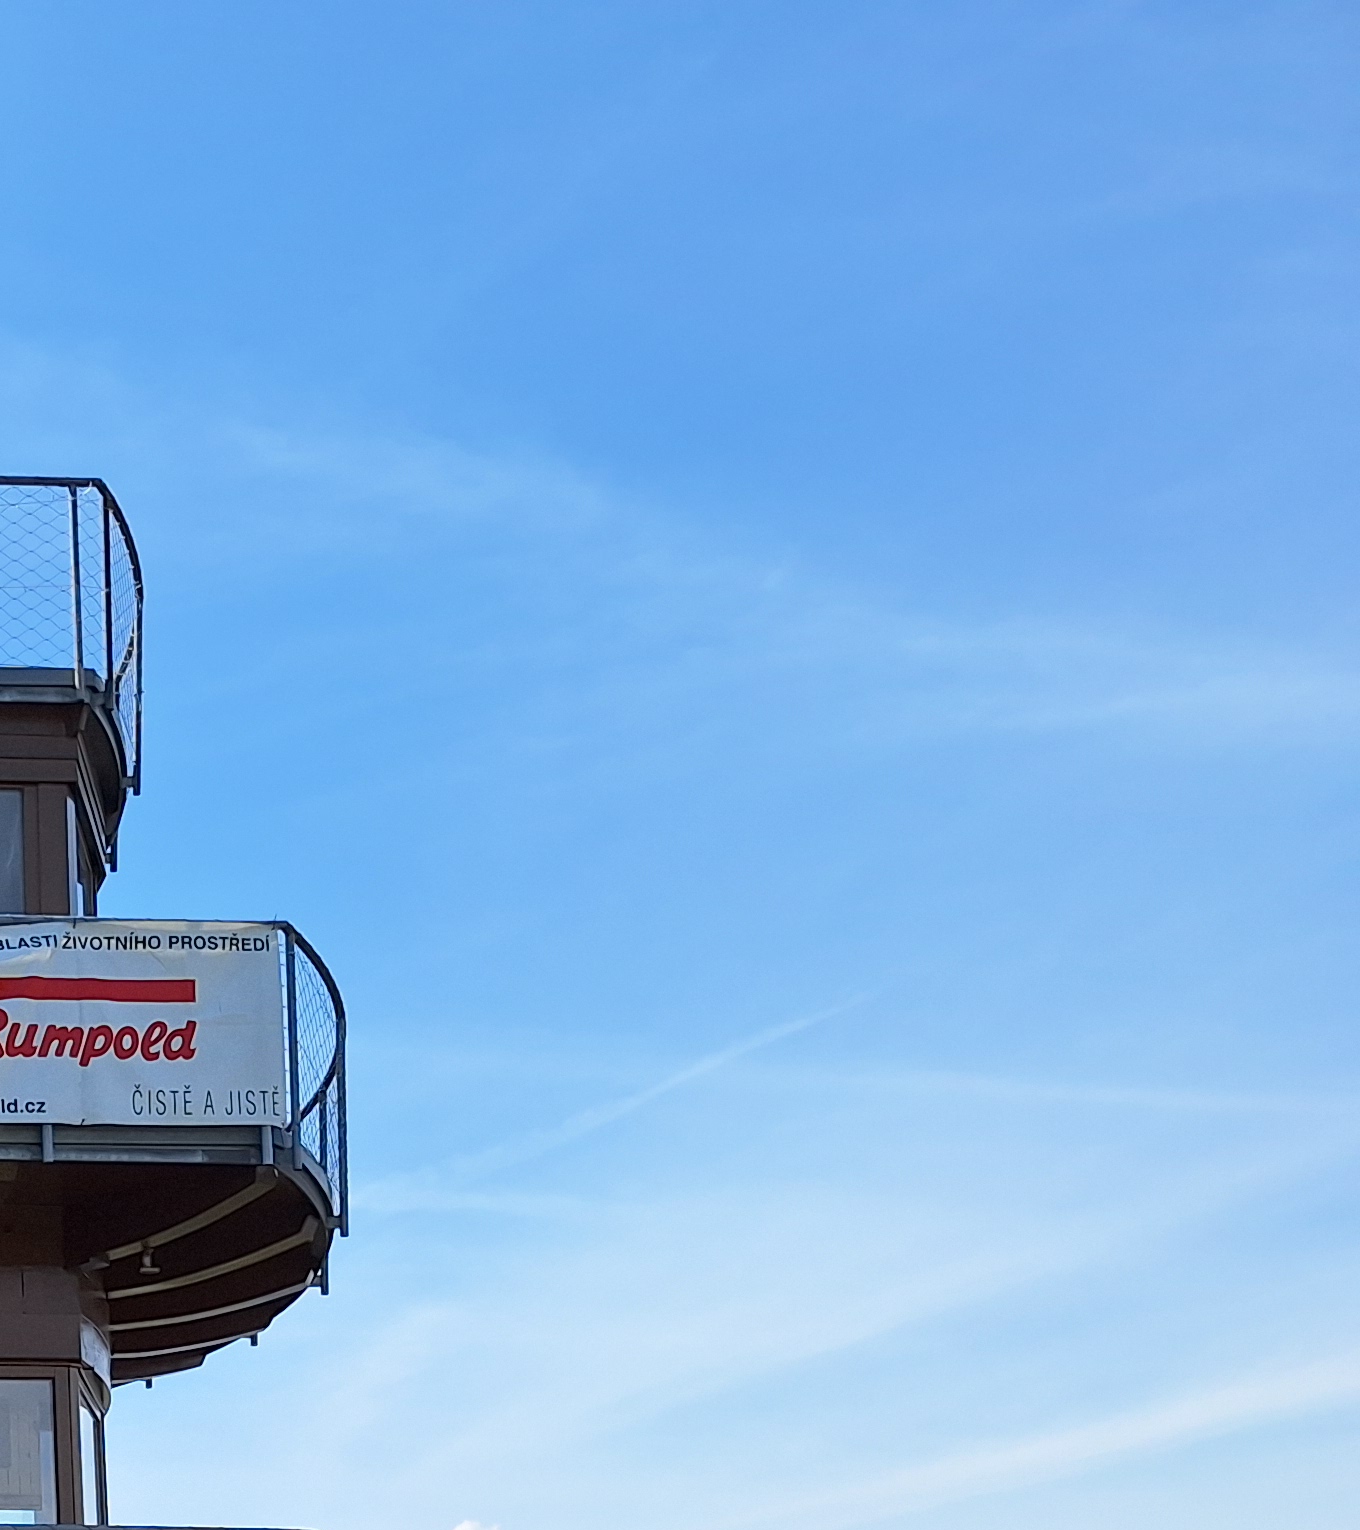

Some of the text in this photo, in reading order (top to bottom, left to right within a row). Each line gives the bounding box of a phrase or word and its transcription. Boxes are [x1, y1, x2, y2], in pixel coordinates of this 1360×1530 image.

[62, 931, 161, 951] ŽIVOTNÍHO
[168, 933, 270, 952] PROSTŘEDÍ
[132, 1084, 281, 1117] ČISTĚ A JISTĚ
